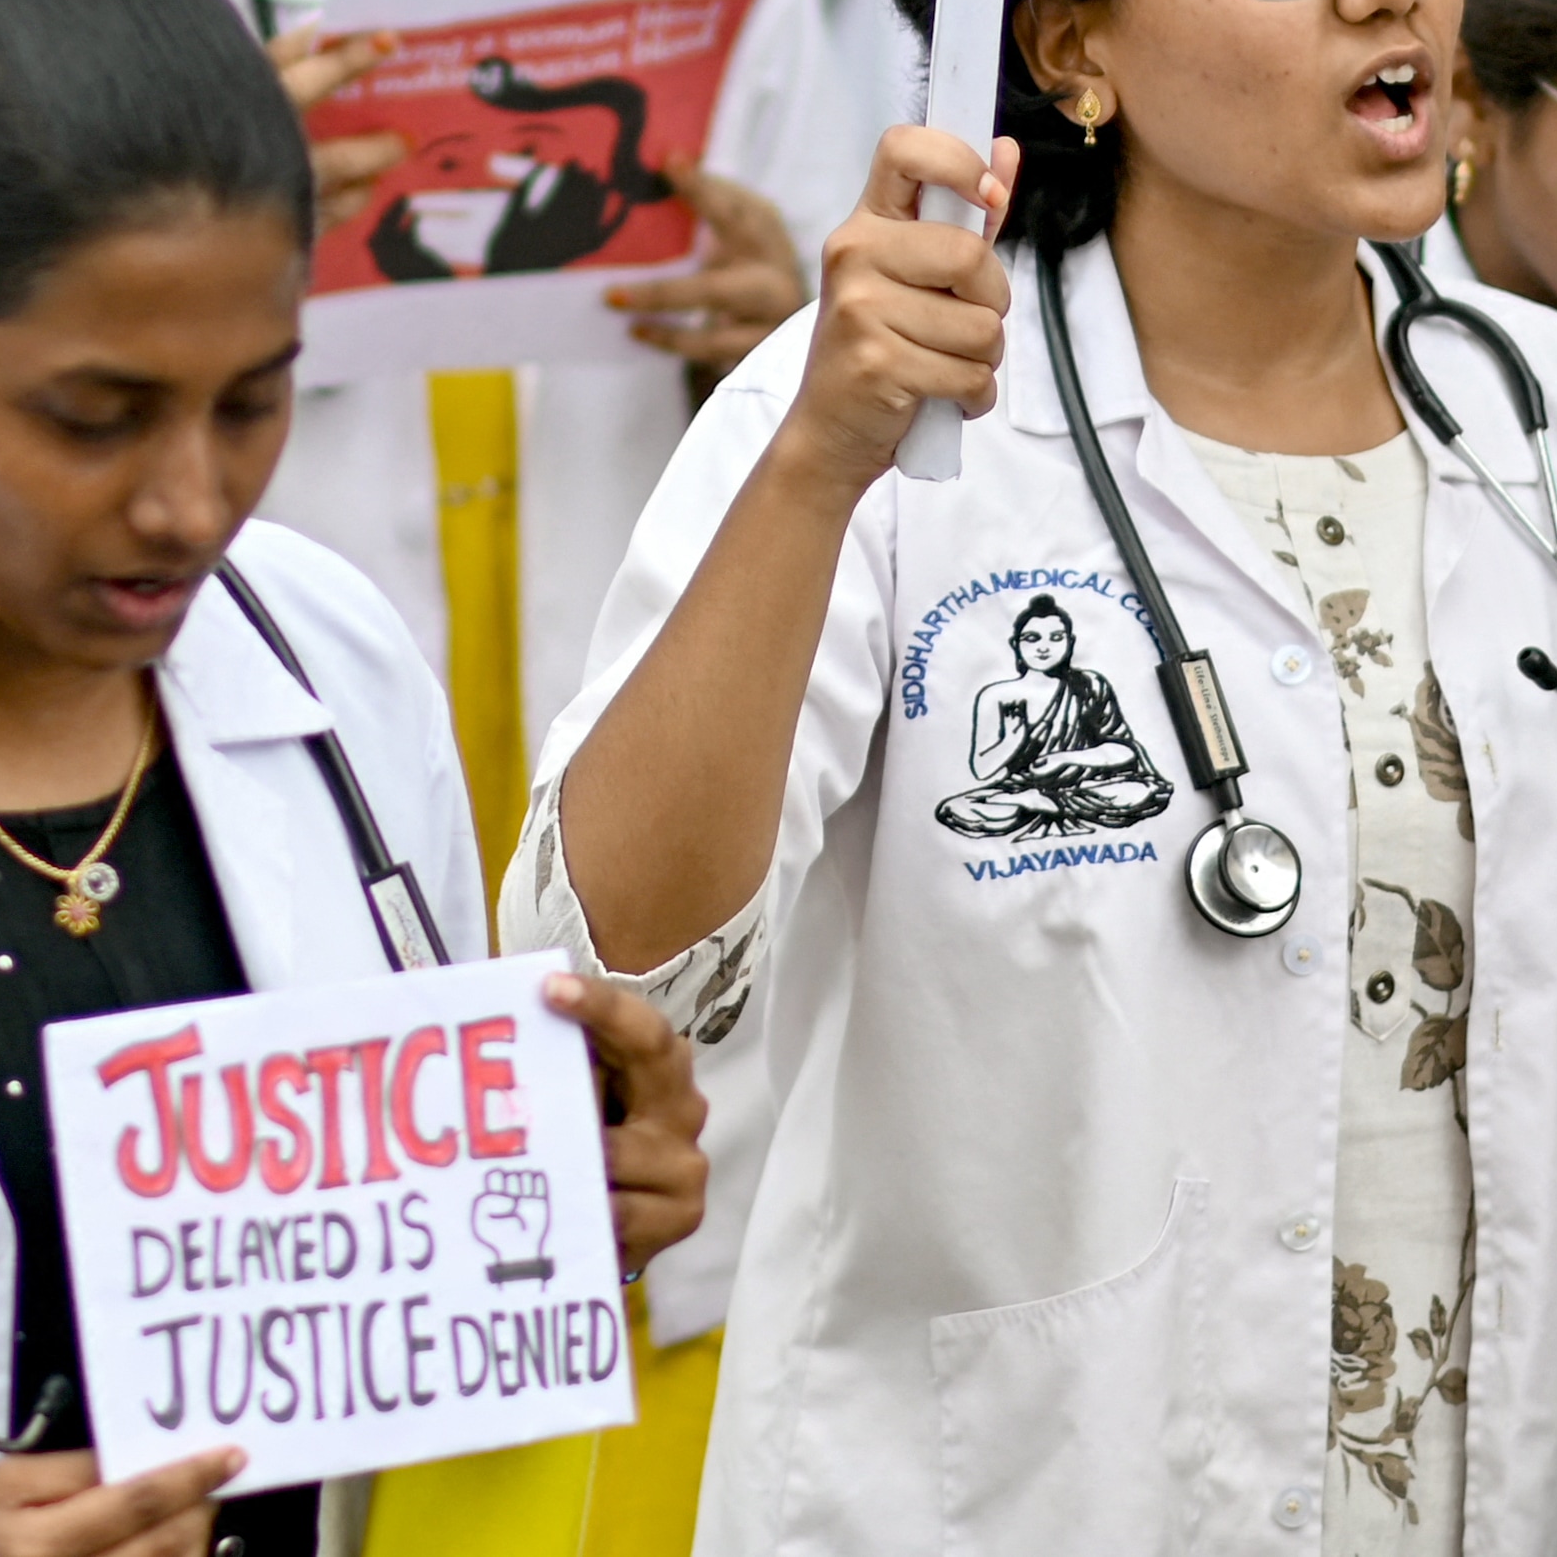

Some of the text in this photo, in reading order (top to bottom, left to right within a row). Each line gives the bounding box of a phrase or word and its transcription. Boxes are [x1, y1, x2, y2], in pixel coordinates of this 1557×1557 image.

[902, 568, 1115, 720] SIDDHARTHA MEDICAL
[964, 841, 1157, 881] VIJAYAWADA
[96, 1015, 528, 1199] JUSTICE
[129, 1190, 435, 1300] DELAYED IS
[142, 1295, 617, 1431] JUSTICE DENIED
